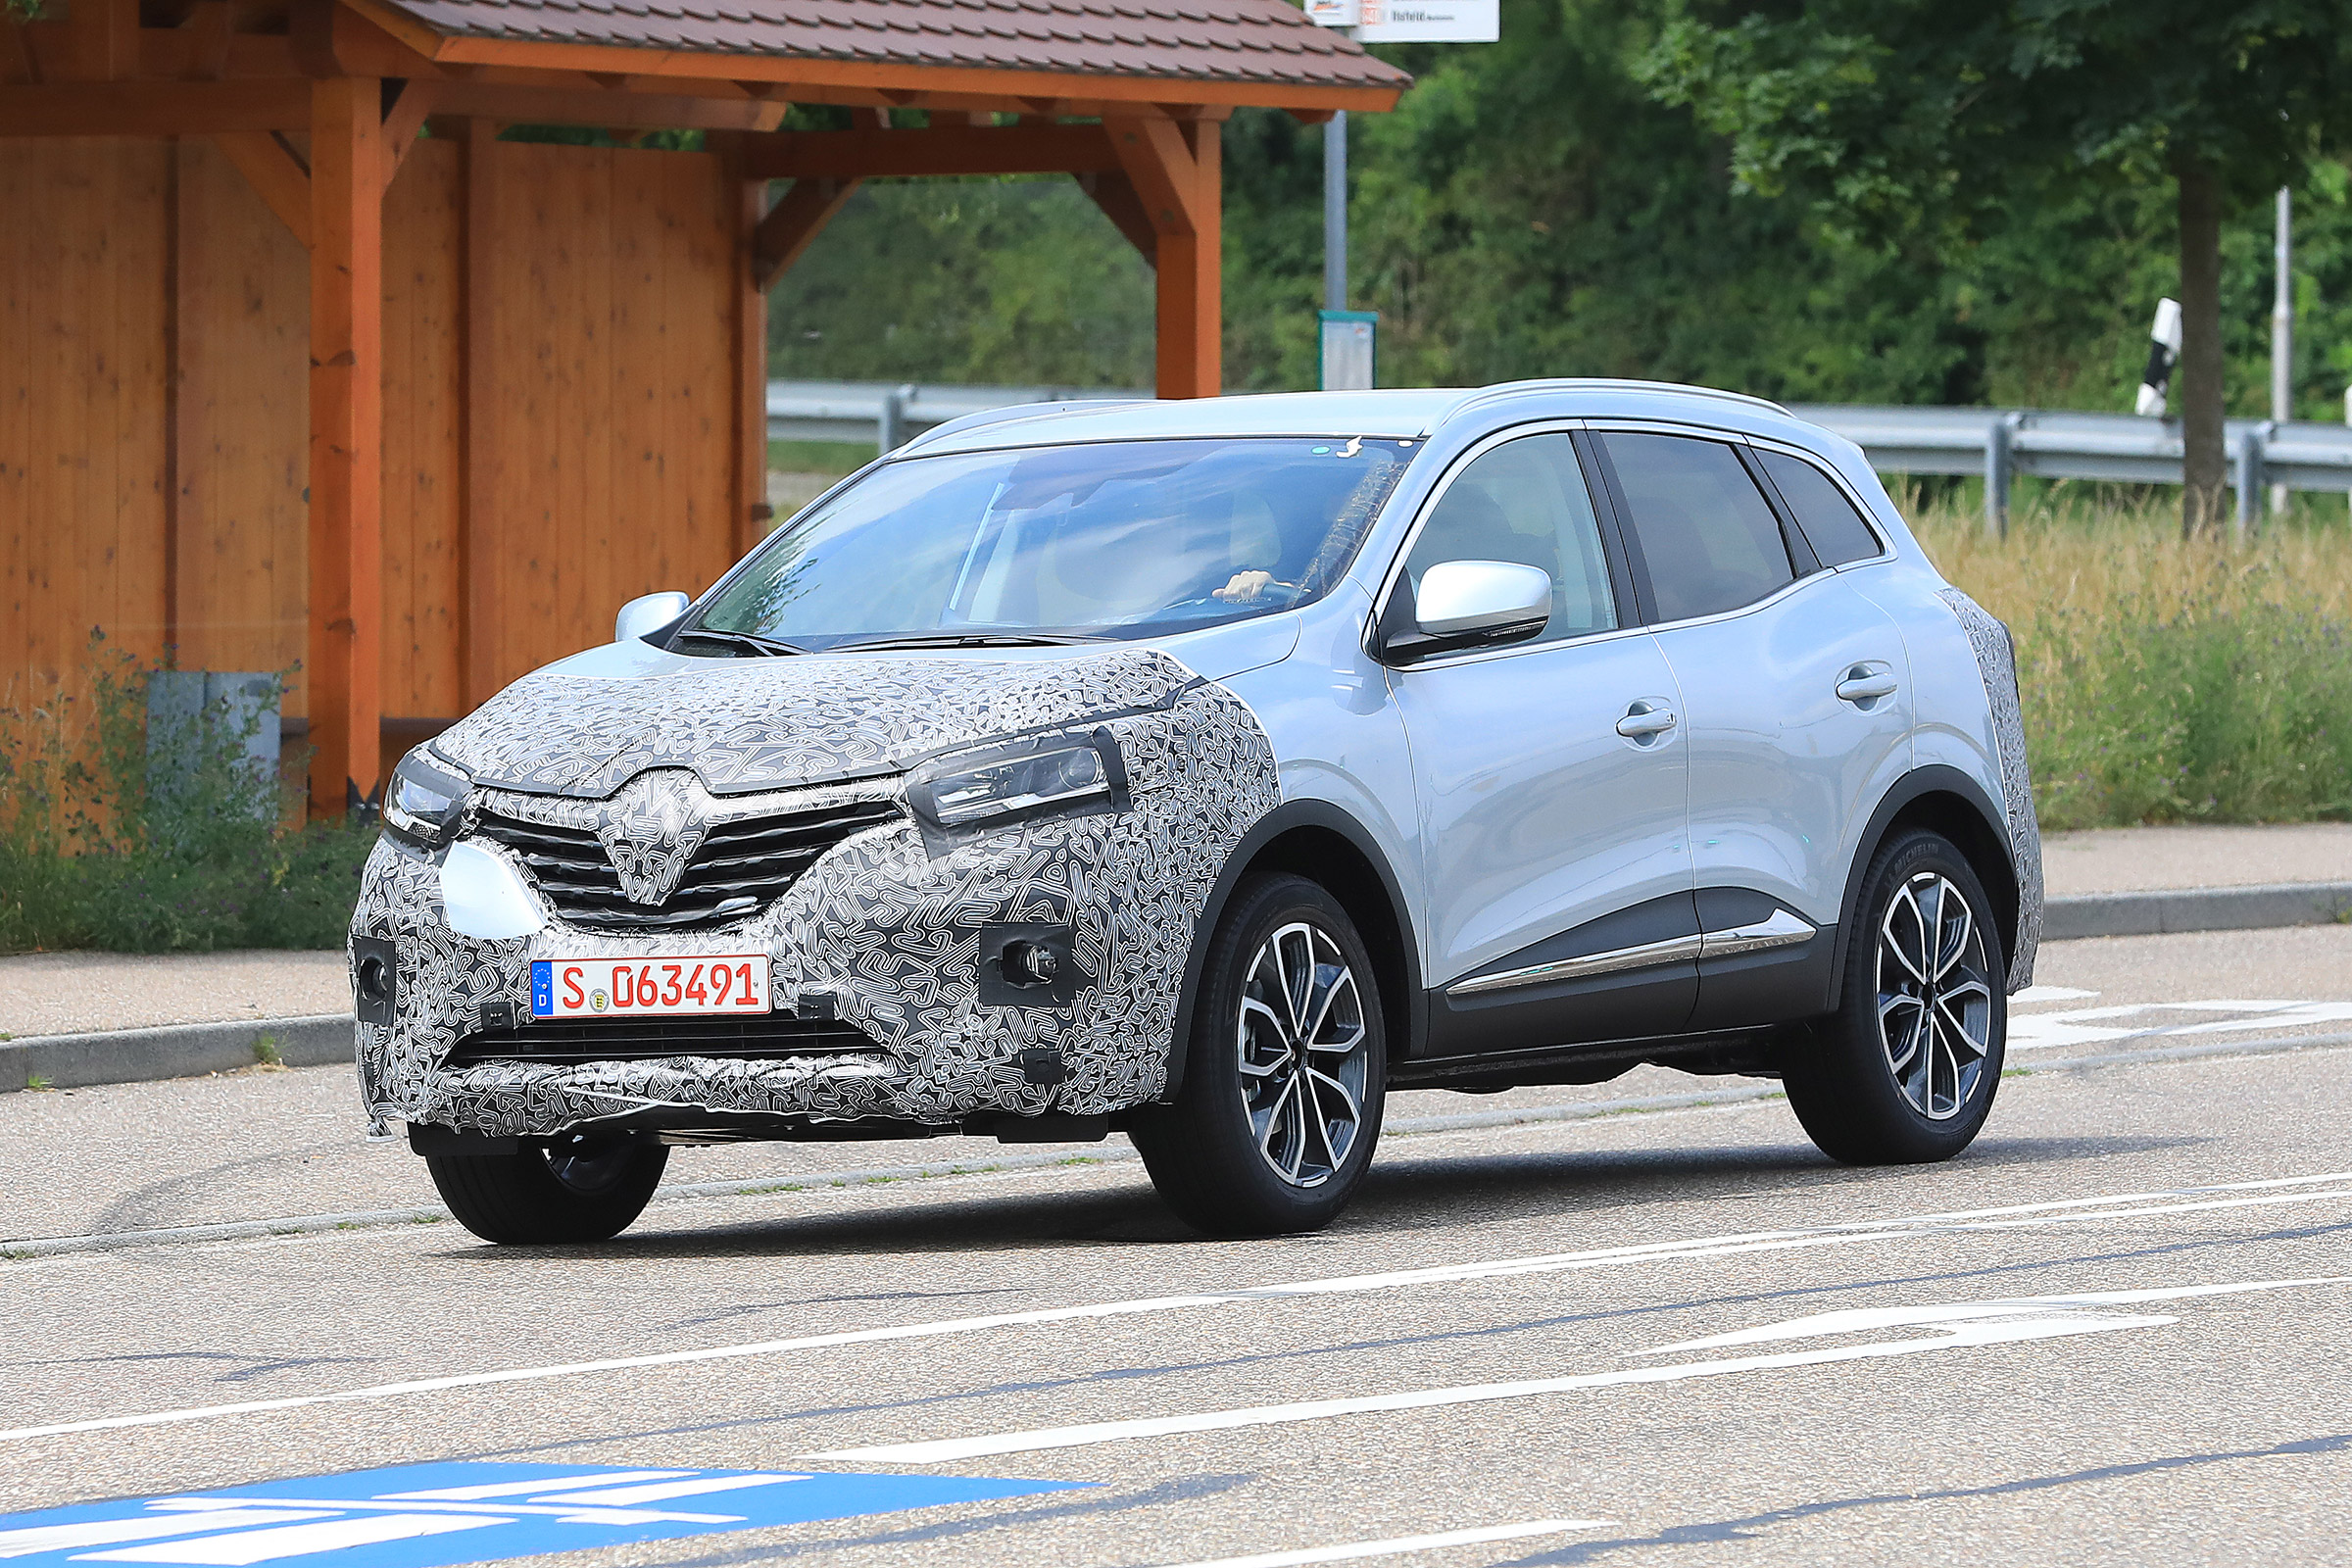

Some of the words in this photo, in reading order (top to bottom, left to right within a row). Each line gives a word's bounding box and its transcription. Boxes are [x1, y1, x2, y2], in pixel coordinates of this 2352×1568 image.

[563, 967, 585, 1008] S
[612, 963, 760, 1007] 063491
[538, 994, 547, 1006] D
